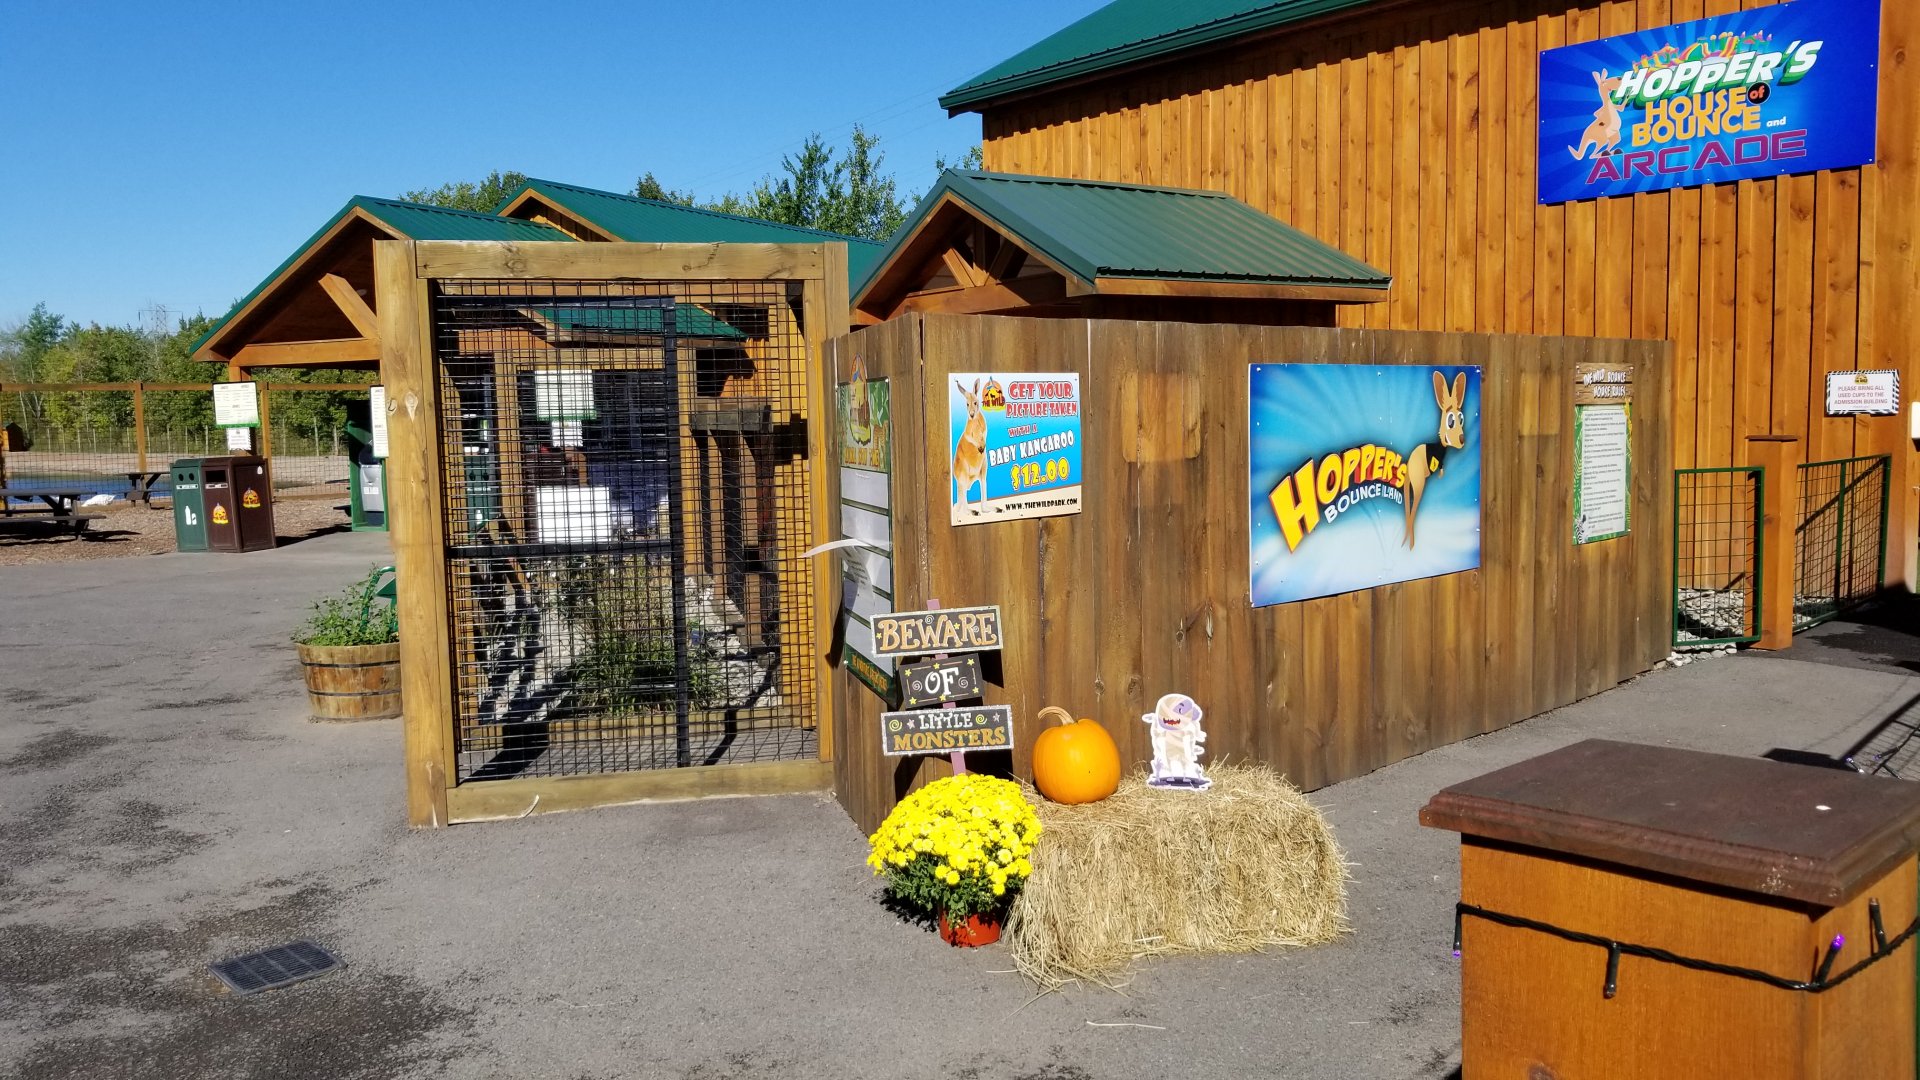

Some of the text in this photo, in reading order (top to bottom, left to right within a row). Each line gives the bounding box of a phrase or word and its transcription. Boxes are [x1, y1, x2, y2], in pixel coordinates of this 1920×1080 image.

[1613, 40, 1823, 104] HOPPER'S
[1645, 86, 1765, 125] HOUSE of
[1631, 105, 1787, 147] BOUNCE and
[1585, 129, 1808, 184] ARCADE
[1008, 381, 1073, 399] GET YOUR
[1006, 401, 1078, 418] PICTURE TAKEN
[988, 430, 1074, 467] BABY KANGAROO
[1010, 457, 1070, 491] $12.00
[1005, 498, 1078, 511] WWW.THEWILDPARK.COM
[1268, 444, 1408, 555] HOPPER'S
[1324, 483, 1404, 524] BOUNCE LAND
[877, 612, 998, 651] BEWARE
[925, 667, 959, 696] OF
[894, 726, 1006, 751] MONSTERS
[918, 712, 974, 730] LITTLE
